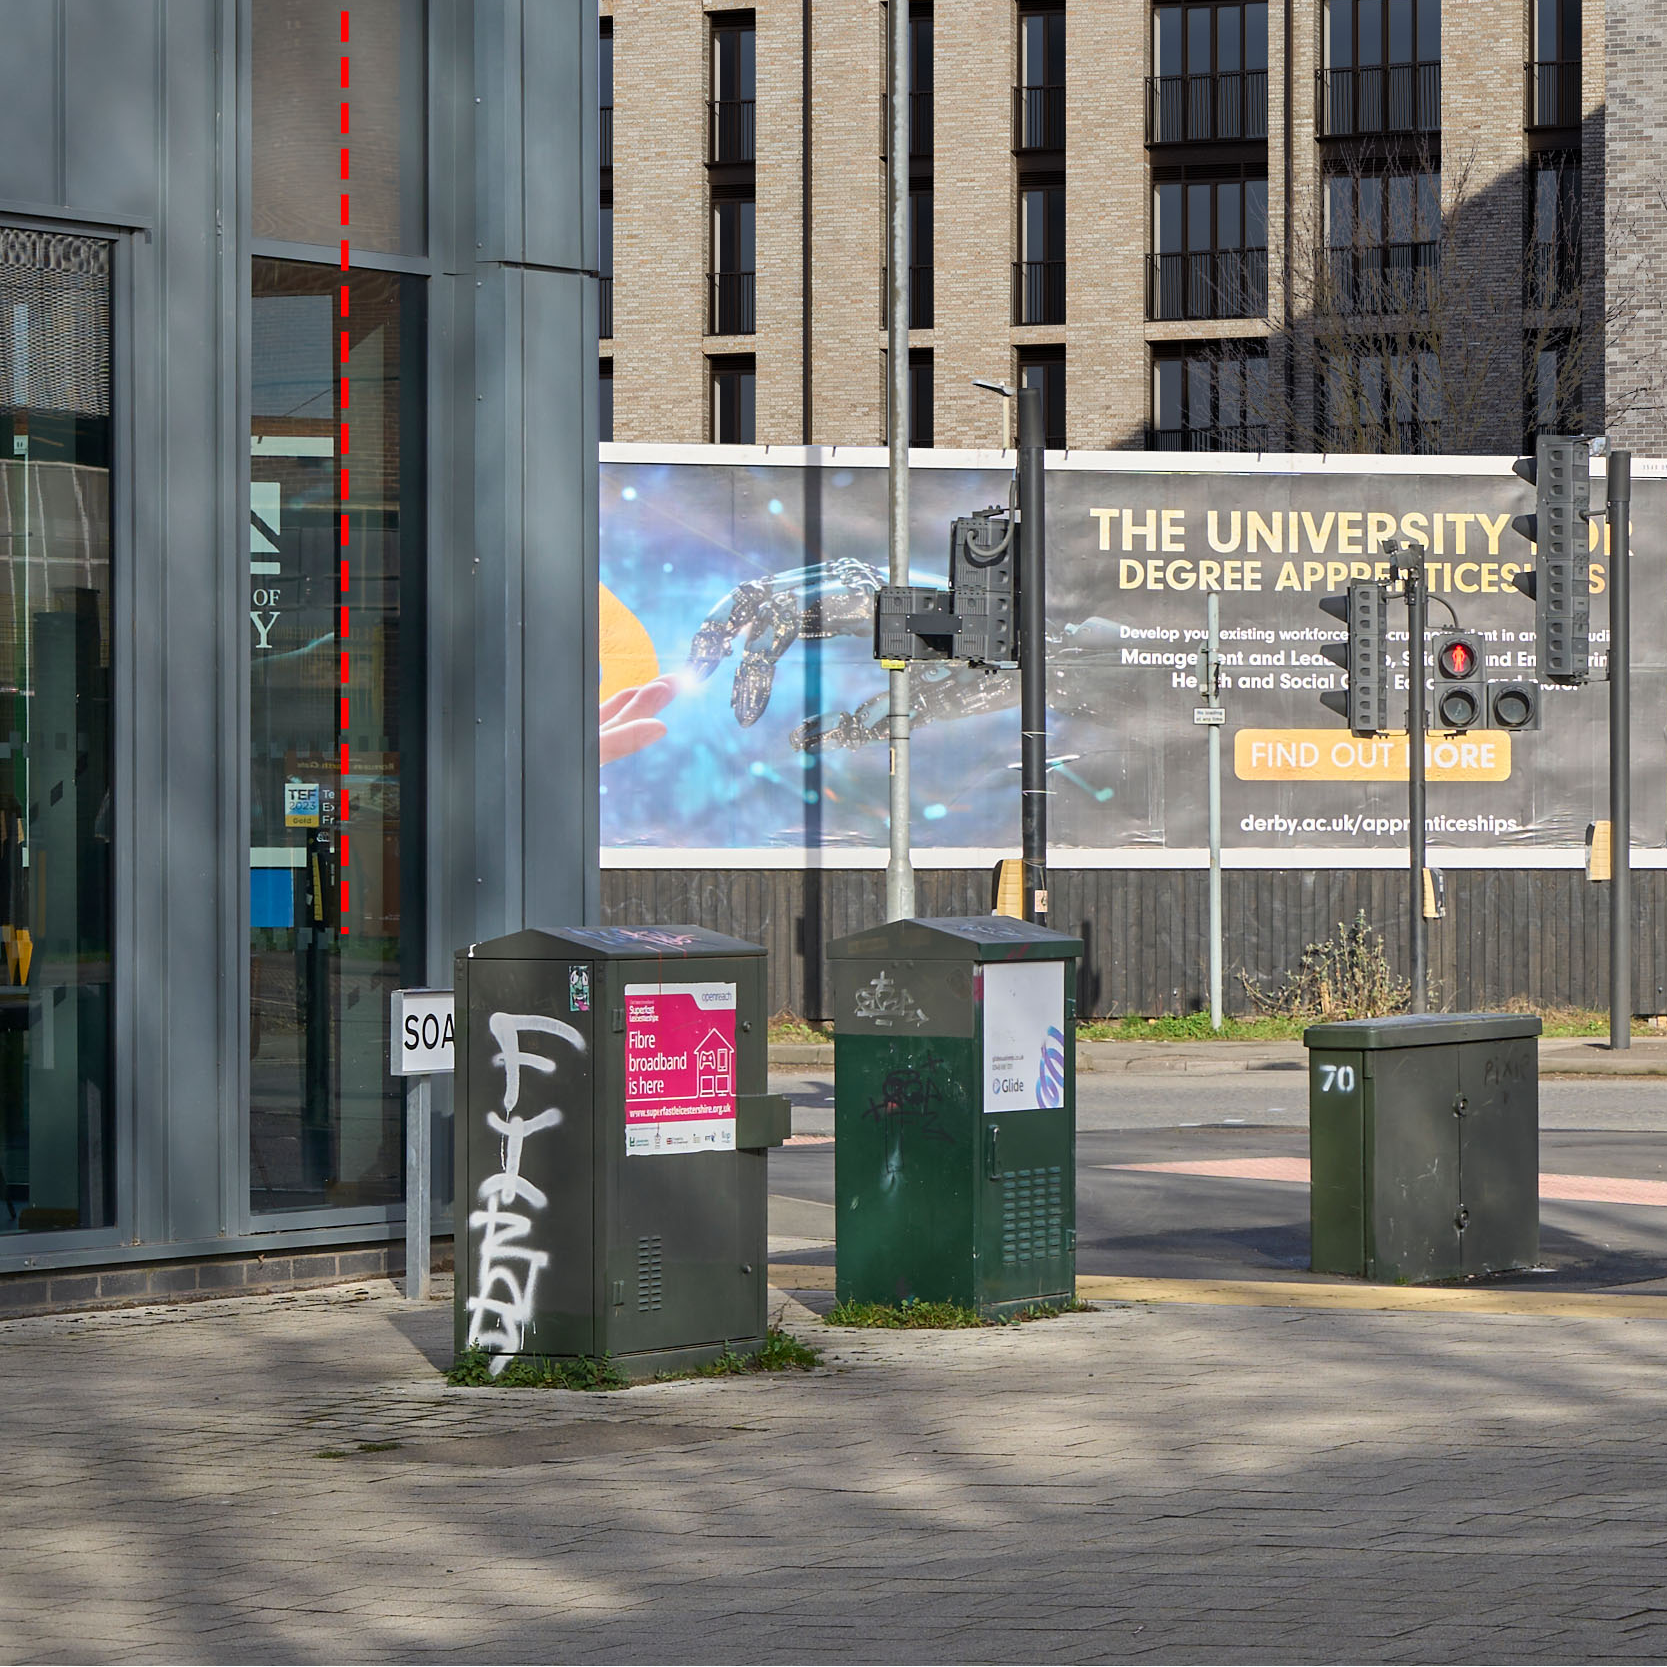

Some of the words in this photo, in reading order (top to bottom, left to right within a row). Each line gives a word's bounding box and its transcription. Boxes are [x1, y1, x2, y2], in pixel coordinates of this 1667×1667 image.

[1089, 508, 1185, 552] THE
[1207, 510, 1511, 555] UNIVERSITY
[1119, 559, 1262, 591] DEGREE
[1274, 561, 1606, 594] APPRETICESS
[253, 589, 281, 606] OF
[1120, 625, 1179, 642] Develop
[1184, 630, 1209, 642] you
[1219, 628, 1275, 644] existing
[1279, 628, 1349, 641] workforce
[1502, 628, 1515, 641] in
[1121, 648, 1244, 669] Manageent
[1249, 650, 1284, 666] and
[1238, 673, 1274, 689] and
[1279, 673, 1335, 689] Social
[1251, 742, 1319, 768] FIND
[1331, 742, 1395, 768] OUT
[288, 789, 317, 801] TEF
[289, 801, 316, 811] 2023
[293, 816, 312, 824] Gold
[1240, 814, 1518, 836] derby.ac.uk/apprnticeships
[702, 992, 732, 1002] openreach
[629, 1005, 655, 1015] Superfast
[629, 1030, 656, 1049] Fibre
[629, 1051, 687, 1072] broadband
[629, 1077, 637, 1095] is
[640, 1076, 664, 1094] here
[1002, 1078, 1024, 1093] Glide
[1319, 1065, 1355, 1092] 70
